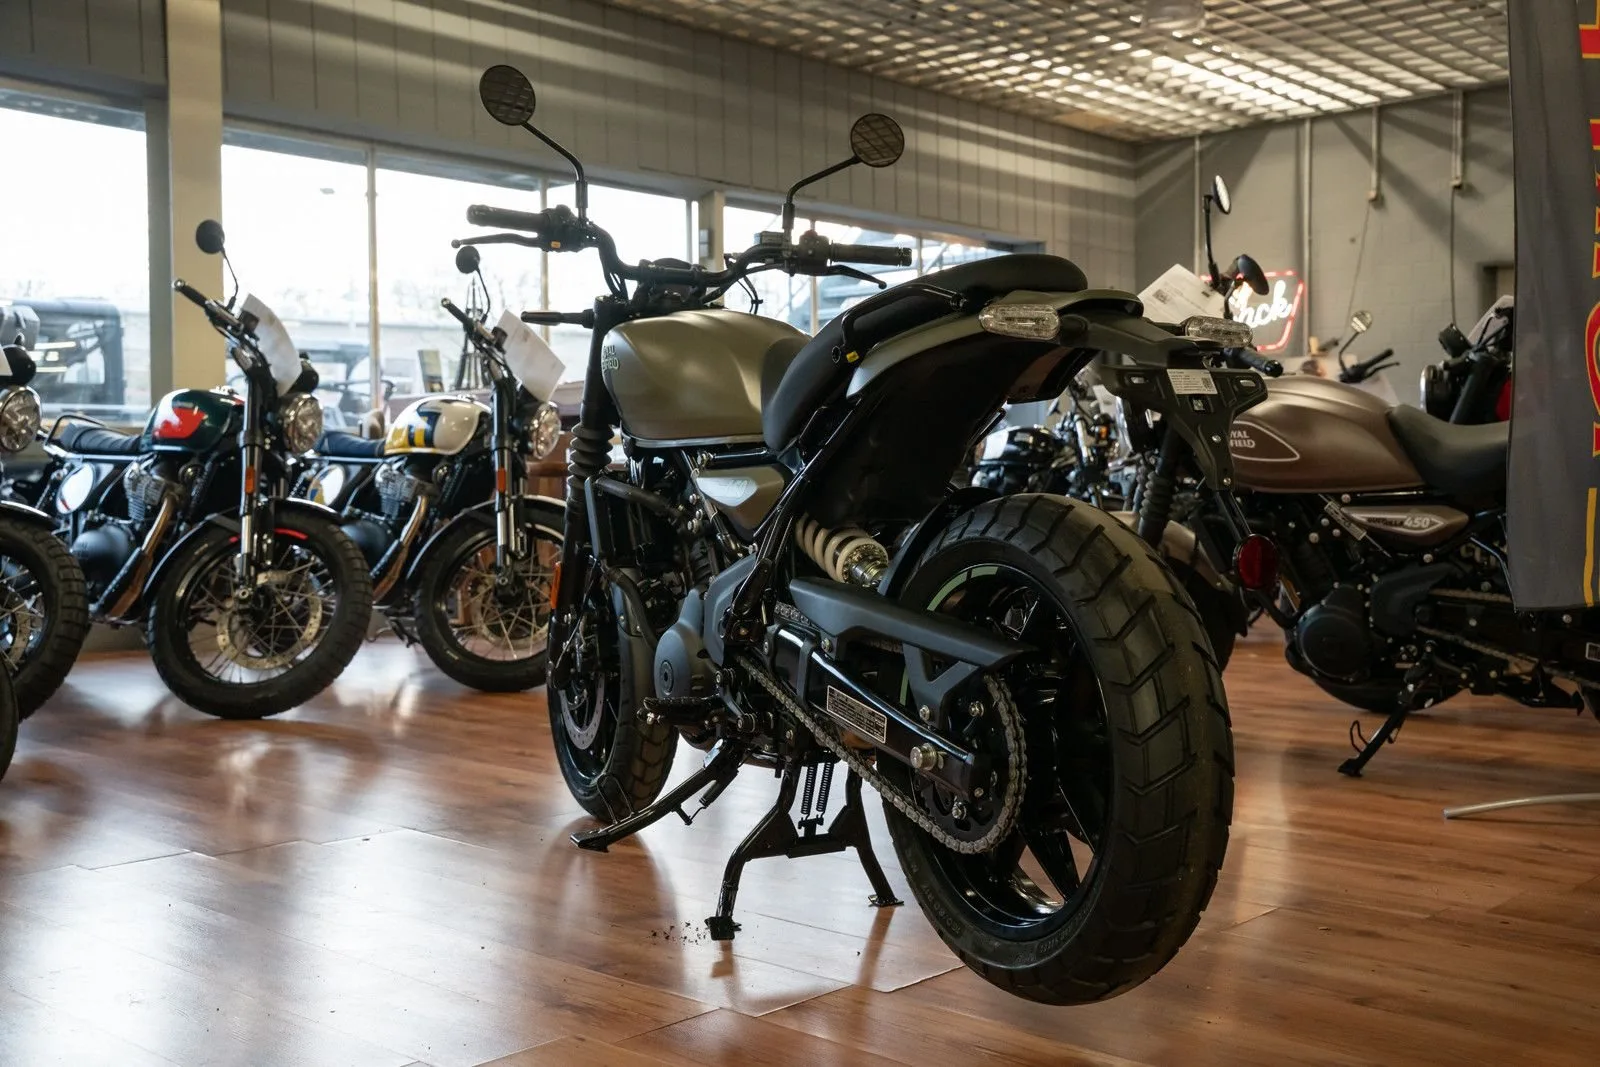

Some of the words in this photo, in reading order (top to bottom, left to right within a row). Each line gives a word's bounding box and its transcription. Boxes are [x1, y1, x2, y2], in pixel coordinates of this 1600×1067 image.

[1230, 430, 1250, 439] YAL
[1229, 439, 1256, 448] FIELD
[1403, 516, 1430, 529] 450
